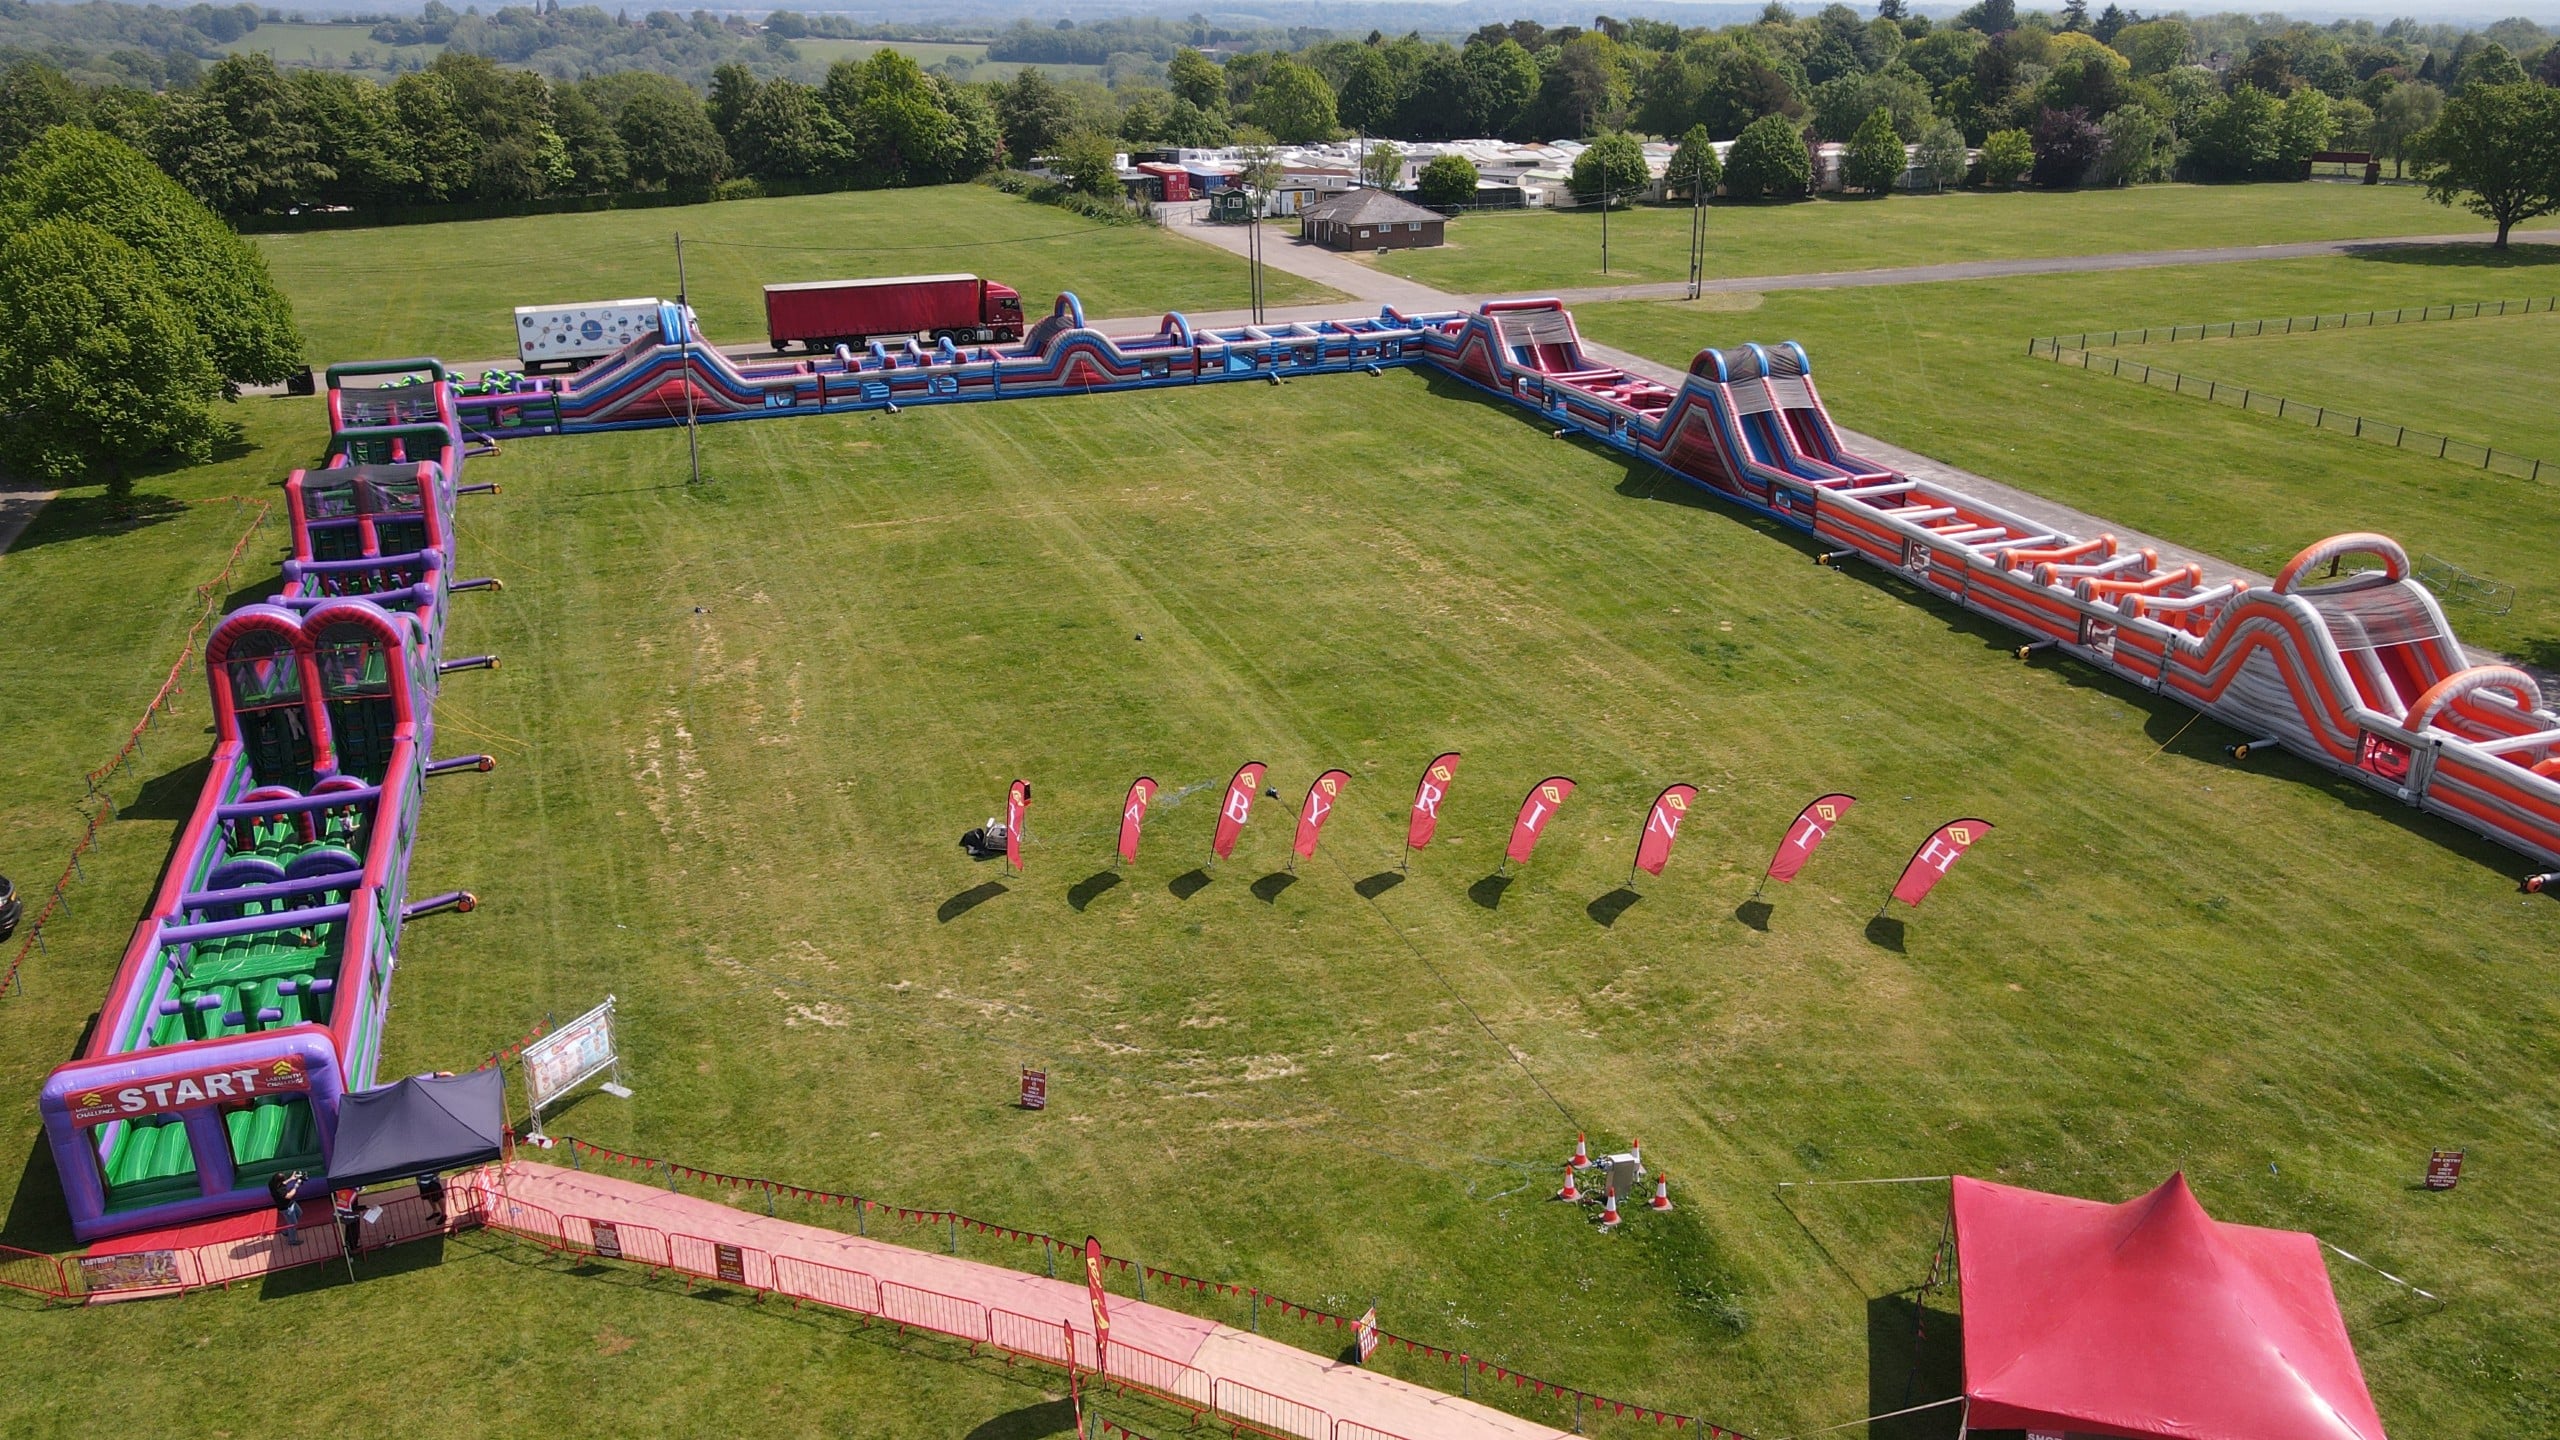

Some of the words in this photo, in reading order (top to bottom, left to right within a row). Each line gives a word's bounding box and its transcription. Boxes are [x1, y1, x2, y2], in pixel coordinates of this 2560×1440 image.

[1124, 803, 1141, 833] A
[1224, 786, 1249, 825] B
[1307, 790, 1331, 827] Y
[1415, 780, 1442, 819] R
[1523, 800, 1547, 832] I
[1648, 805, 1681, 839] N
[1793, 814, 1826, 850] T
[1918, 835, 1960, 874] H
[118, 1068, 260, 1113] START
